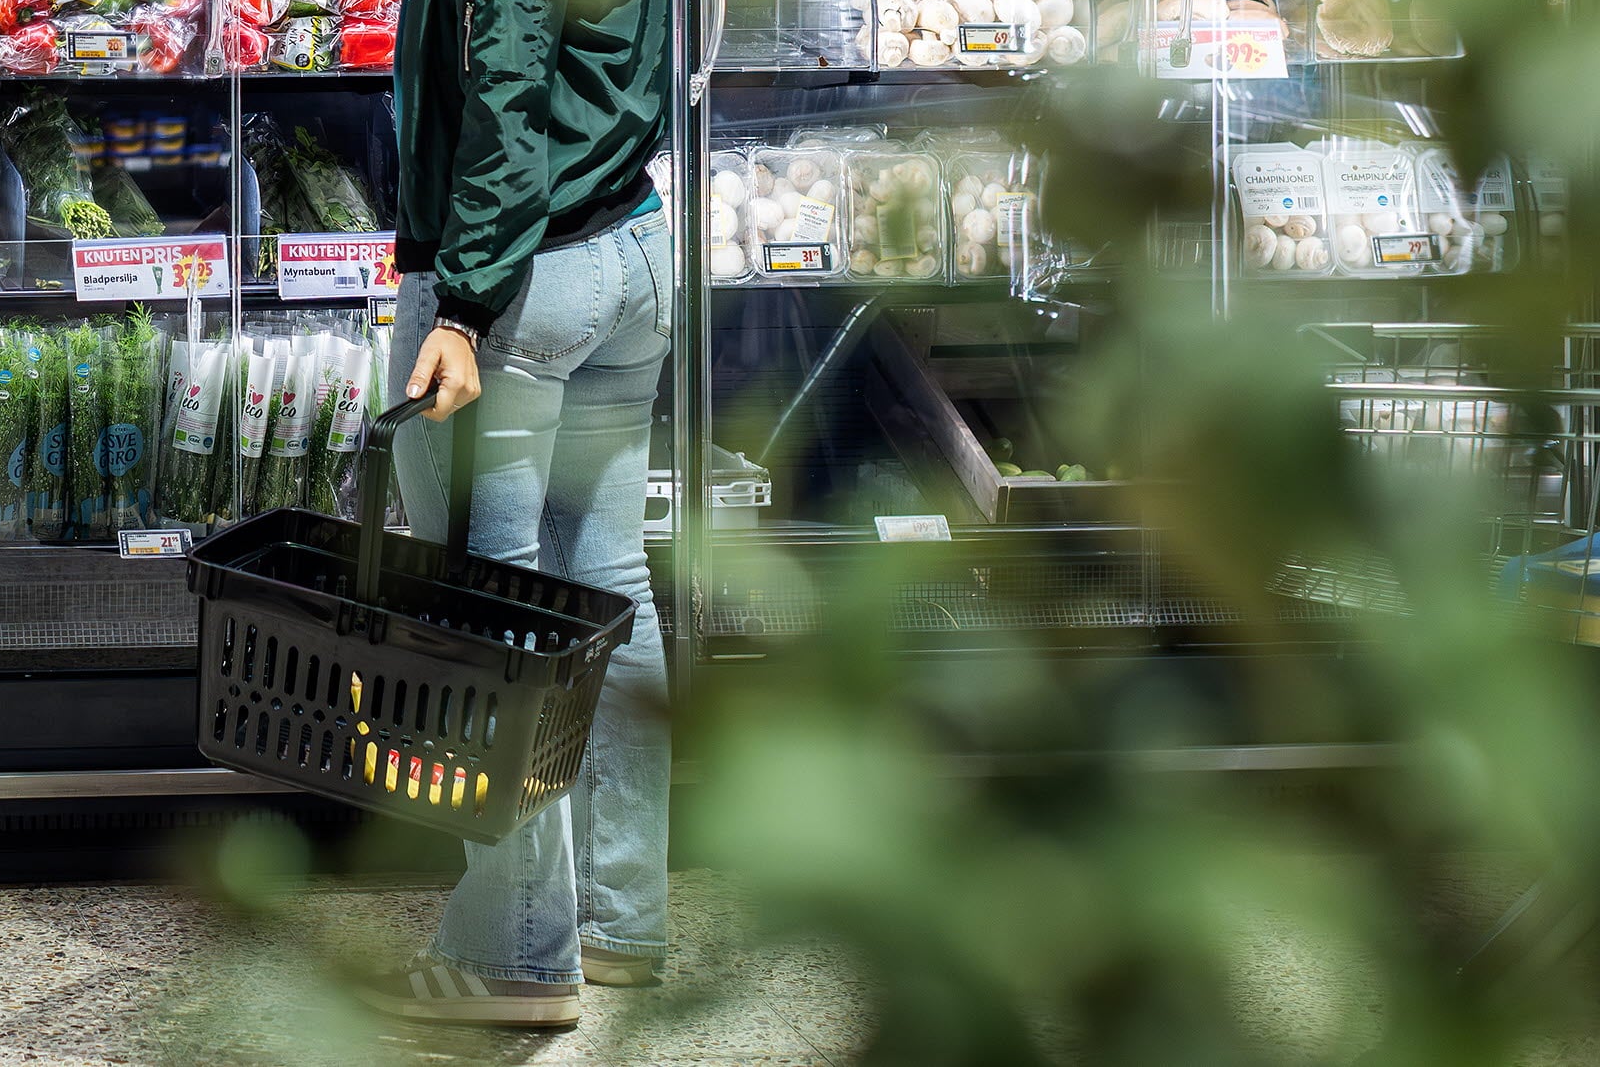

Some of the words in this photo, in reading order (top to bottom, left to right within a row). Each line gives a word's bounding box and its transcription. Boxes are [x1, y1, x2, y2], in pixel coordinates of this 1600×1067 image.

[1245, 173, 1315, 185] CHAMPINJONER
[1341, 172, 1409, 183] CHAMPINJONE
[83, 273, 138, 284] Bladpersilja
[284, 267, 336, 278] Myntabunt
[342, 386, 349, 399] i
[182, 397, 200, 411] eco
[338, 400, 358, 413] eco
[245, 403, 263, 419] eco
